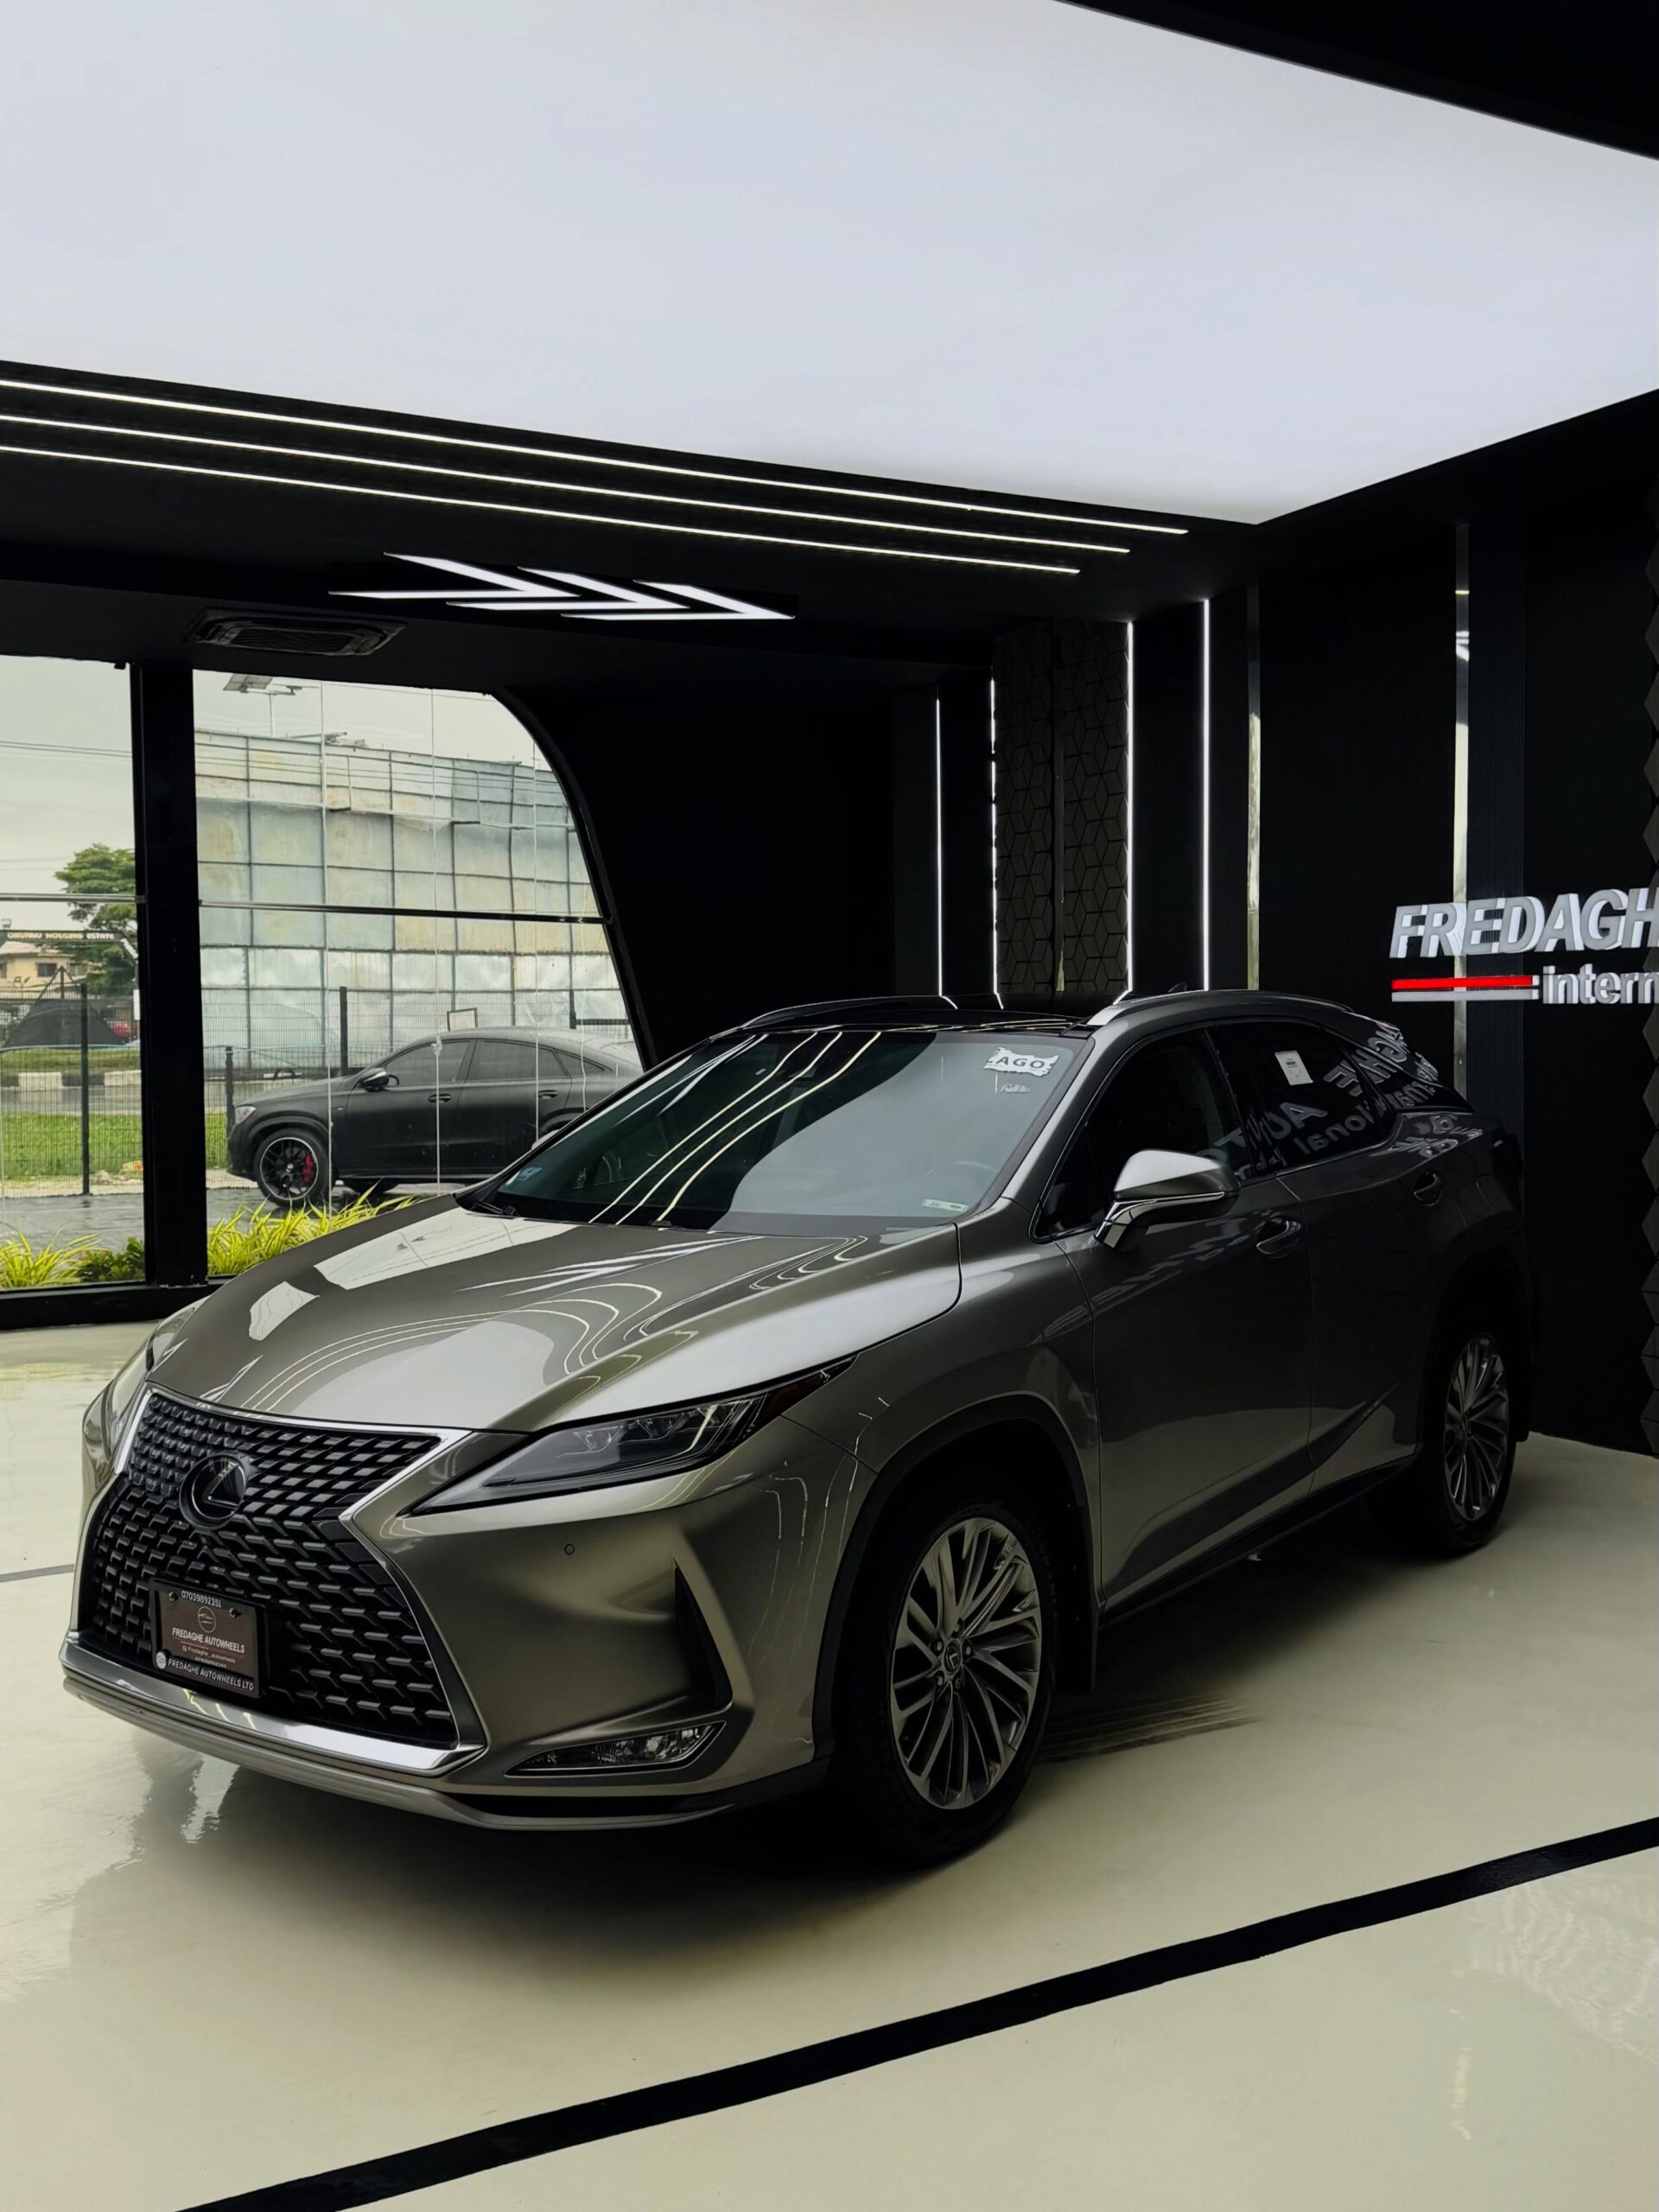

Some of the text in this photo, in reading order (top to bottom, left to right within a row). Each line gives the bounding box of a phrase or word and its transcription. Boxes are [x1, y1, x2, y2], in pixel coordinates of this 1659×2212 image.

[1389, 888, 1659, 958] FREDAGH
[1542, 963, 1659, 1004] intern
[172, 1627, 245, 1653] FREDAGHE AUTOWHEELS
[168, 1658, 199, 1675] FREDAGHE
[200, 1668, 241, 1688] AUTOWHEELS
[242, 1678, 254, 1691] LTD
